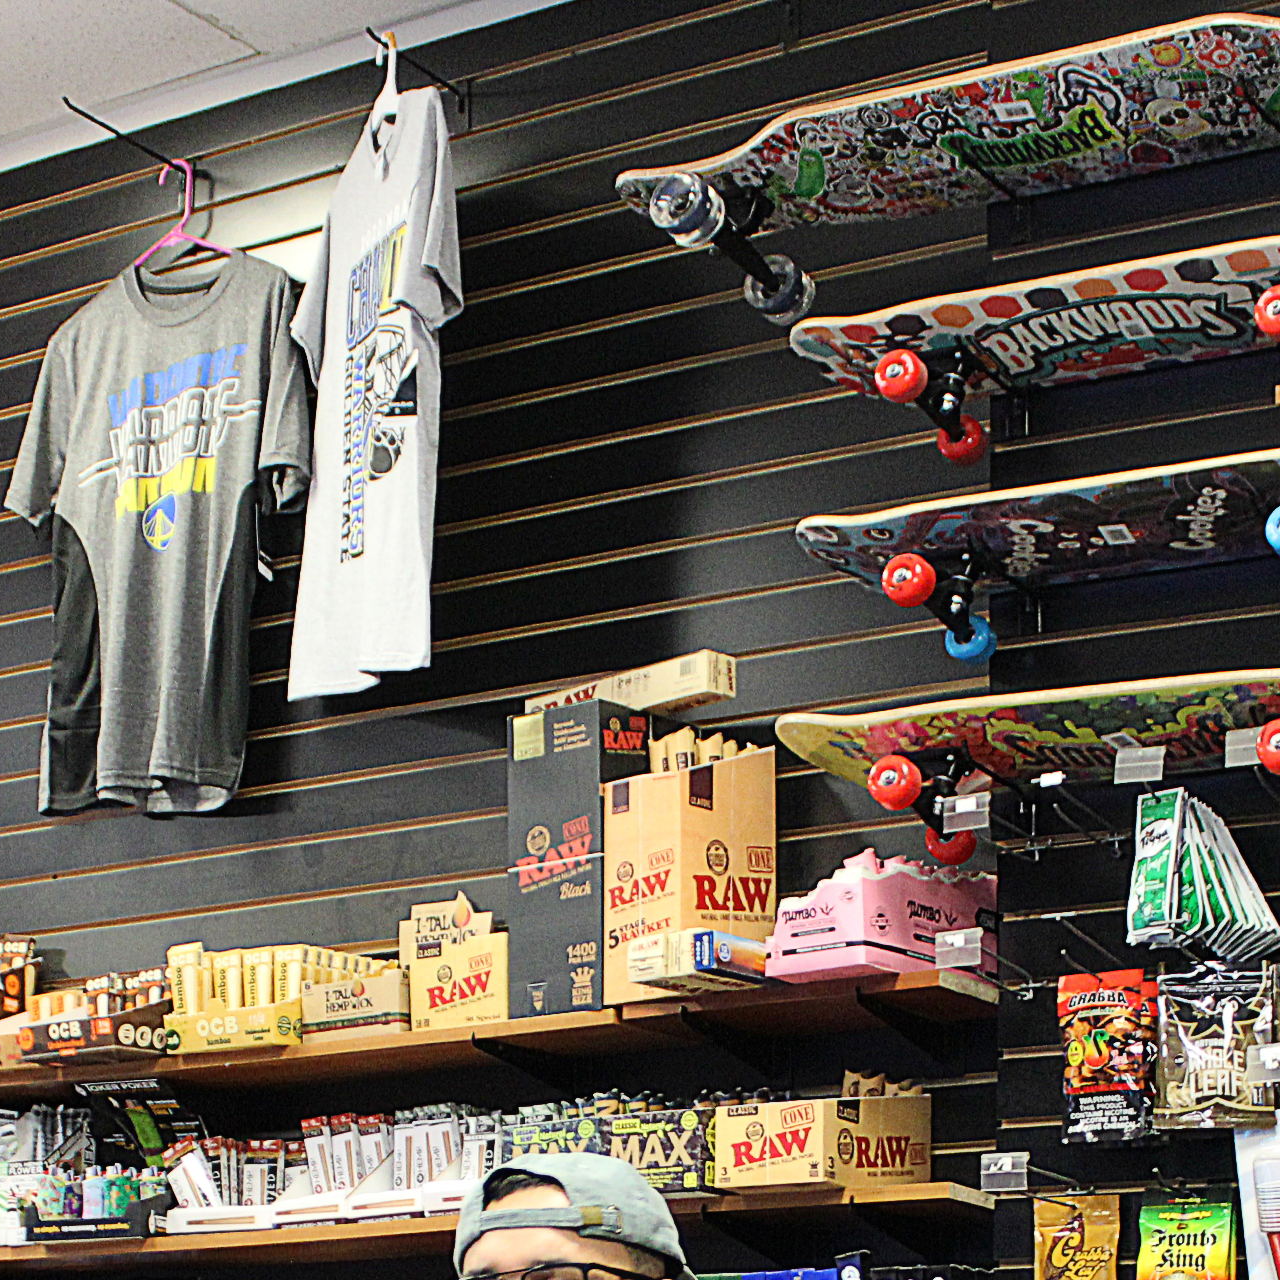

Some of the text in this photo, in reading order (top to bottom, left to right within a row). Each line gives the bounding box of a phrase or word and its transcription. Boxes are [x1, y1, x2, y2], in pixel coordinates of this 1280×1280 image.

[987, 297, 1227, 377] BACKWOODS
[603, 730, 644, 750] RAW
[516, 833, 594, 887] RAW
[649, 850, 674, 869] CONE
[748, 848, 773, 872] CONE
[559, 877, 592, 900] Black
[608, 869, 671, 909] RAW
[693, 874, 772, 913] RAW
[782, 906, 817, 924] JUMBO
[907, 900, 941, 924] JUMBO
[415, 915, 451, 934] I-TAL
[620, 918, 671, 943] RAWKET
[4, 940, 27, 954] OCB
[566, 942, 597, 956] 1400
[608, 929, 620, 949] 5
[170, 955, 194, 967] OCB
[213, 954, 239, 968] OCB
[243, 951, 269, 965] OCB
[275, 949, 301, 961] OCB
[469, 953, 492, 972] CONE
[86, 976, 109, 991] OCB
[139, 968, 162, 983] OCB
[176, 967, 185, 1009] bamboo
[325, 989, 351, 1003] I-TAL
[426, 970, 492, 1010] RAW
[1069, 990, 1128, 1008] GRABBA
[196, 1016, 239, 1038] OCB
[476, 1013, 501, 1022] Special
[49, 1021, 80, 1041] OCB
[86, 1080, 159, 1092] TOKER POKER
[1189, 1069, 1244, 1098] LEAF
[1079, 1096, 1125, 1105] WARNING:
[728, 1106, 758, 1116] CLASSIC
[782, 1106, 813, 1128] CONE
[610, 1128, 697, 1168] MAX
[732, 1127, 812, 1167] RAW
[856, 1136, 910, 1168] RAW
[721, 1166, 728, 1177] 3
[1151, 1228, 1217, 1248] Fronto
[1051, 1232, 1113, 1268] Grabba
[1155, 1248, 1206, 1272] King
